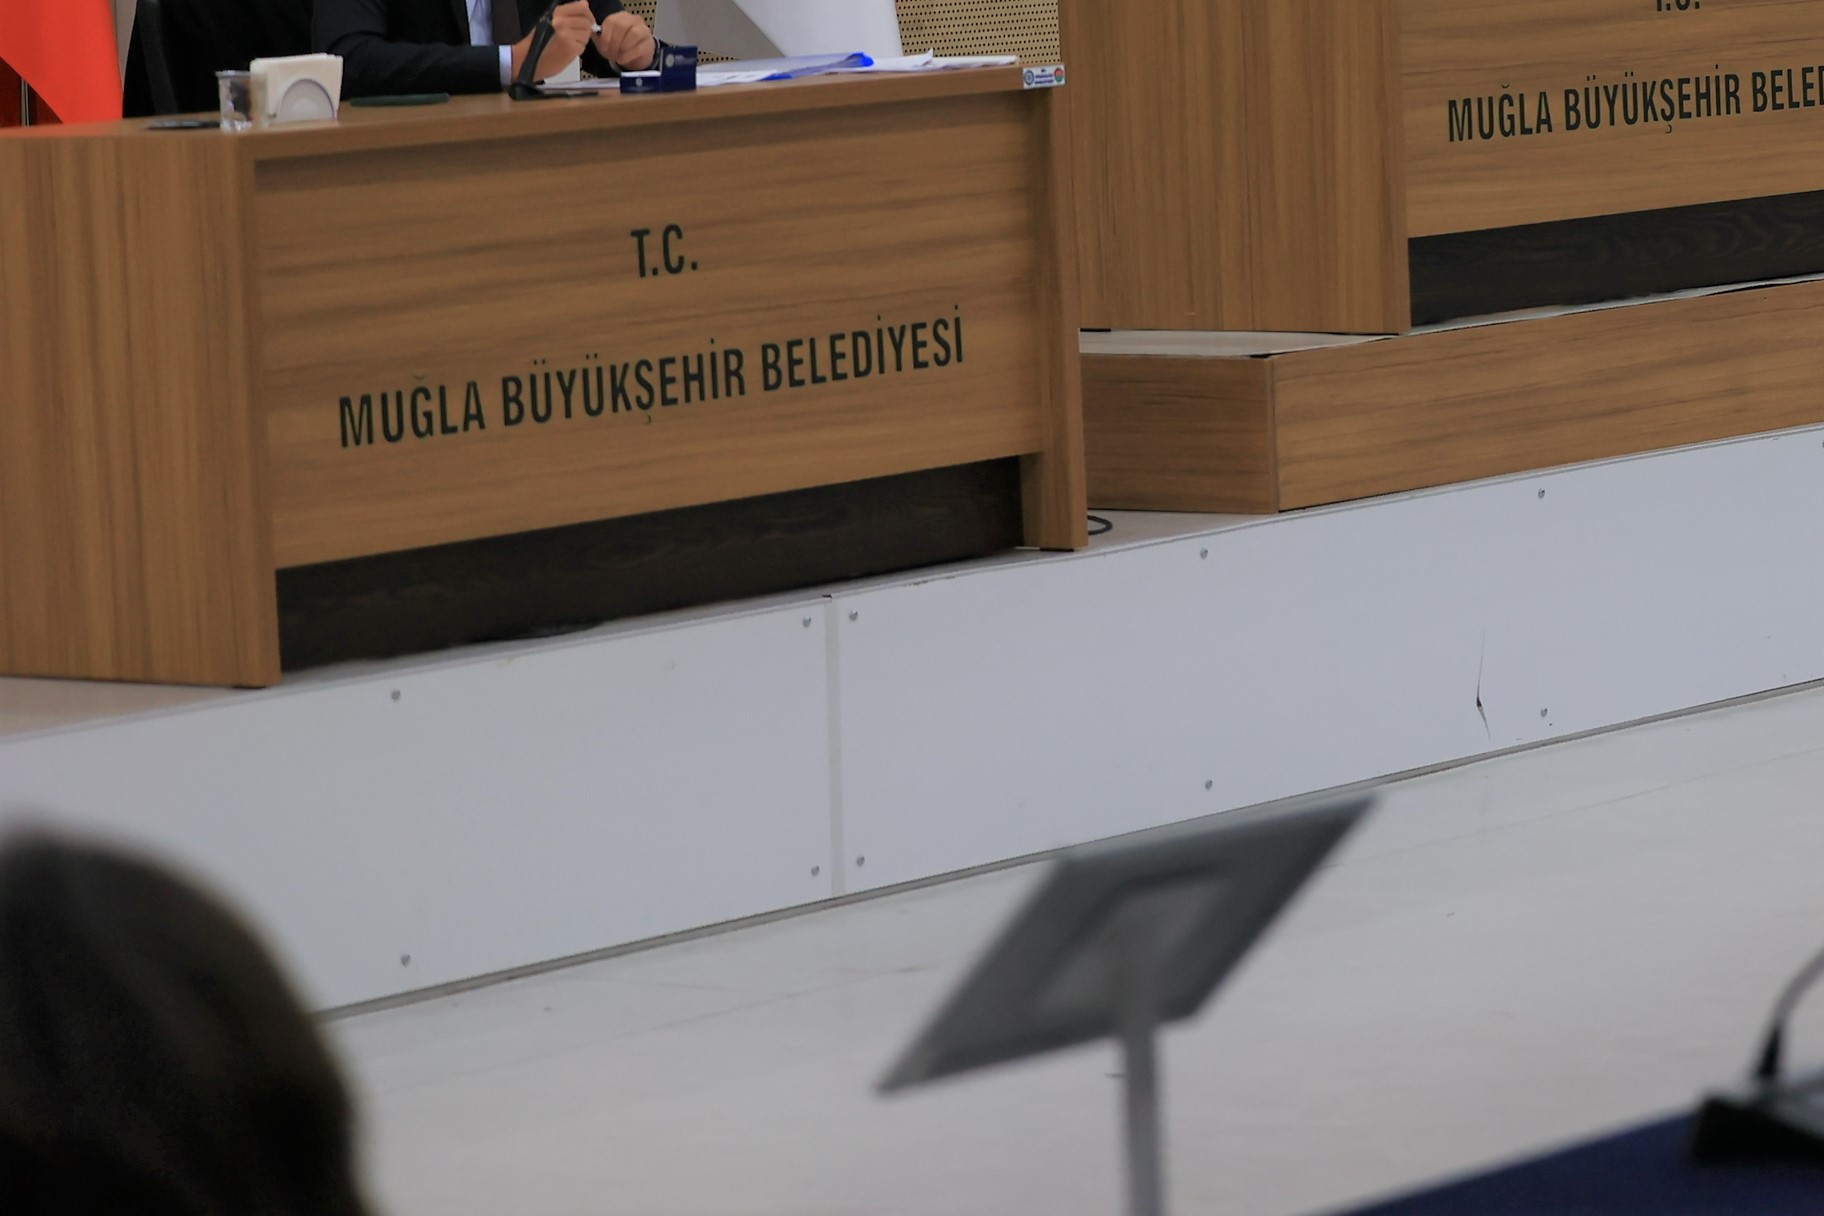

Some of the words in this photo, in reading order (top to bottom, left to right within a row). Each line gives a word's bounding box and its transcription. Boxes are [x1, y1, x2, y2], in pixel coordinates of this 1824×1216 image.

[1448, 84, 1553, 142] MUĞLA
[1564, 64, 1741, 133] BÜYÜKŞEHİR
[631, 224, 699, 277] T.C.
[502, 338, 746, 426] BÜYÜKŞEHİR
[761, 304, 964, 391] BELEDİYESİ
